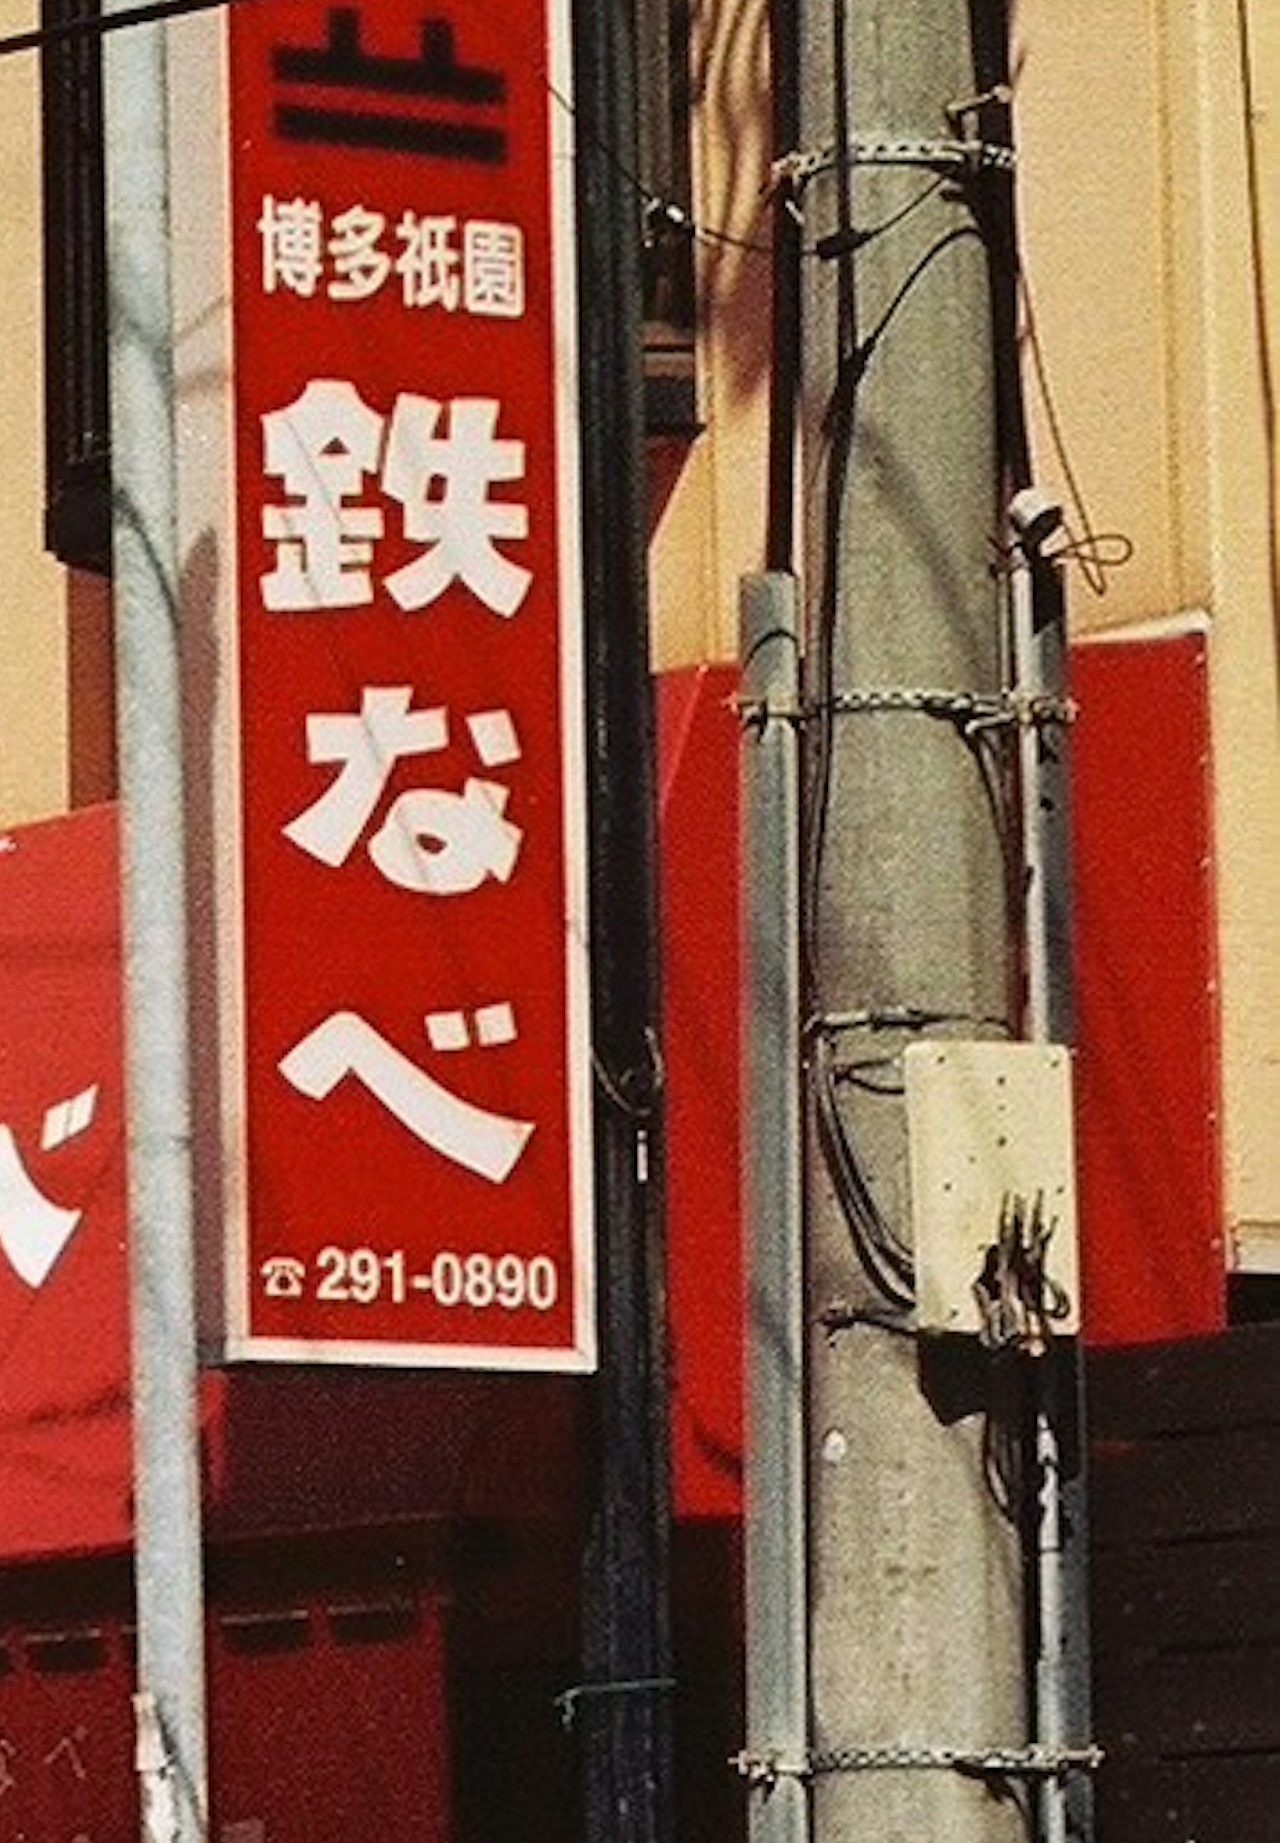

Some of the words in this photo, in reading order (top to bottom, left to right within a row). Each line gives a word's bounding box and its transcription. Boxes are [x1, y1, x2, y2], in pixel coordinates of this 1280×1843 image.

[256, 194, 526, 318] 博多祇園
[259, 379, 535, 1184] 鉄なべ
[316, 1247, 557, 1311] 291-0890
